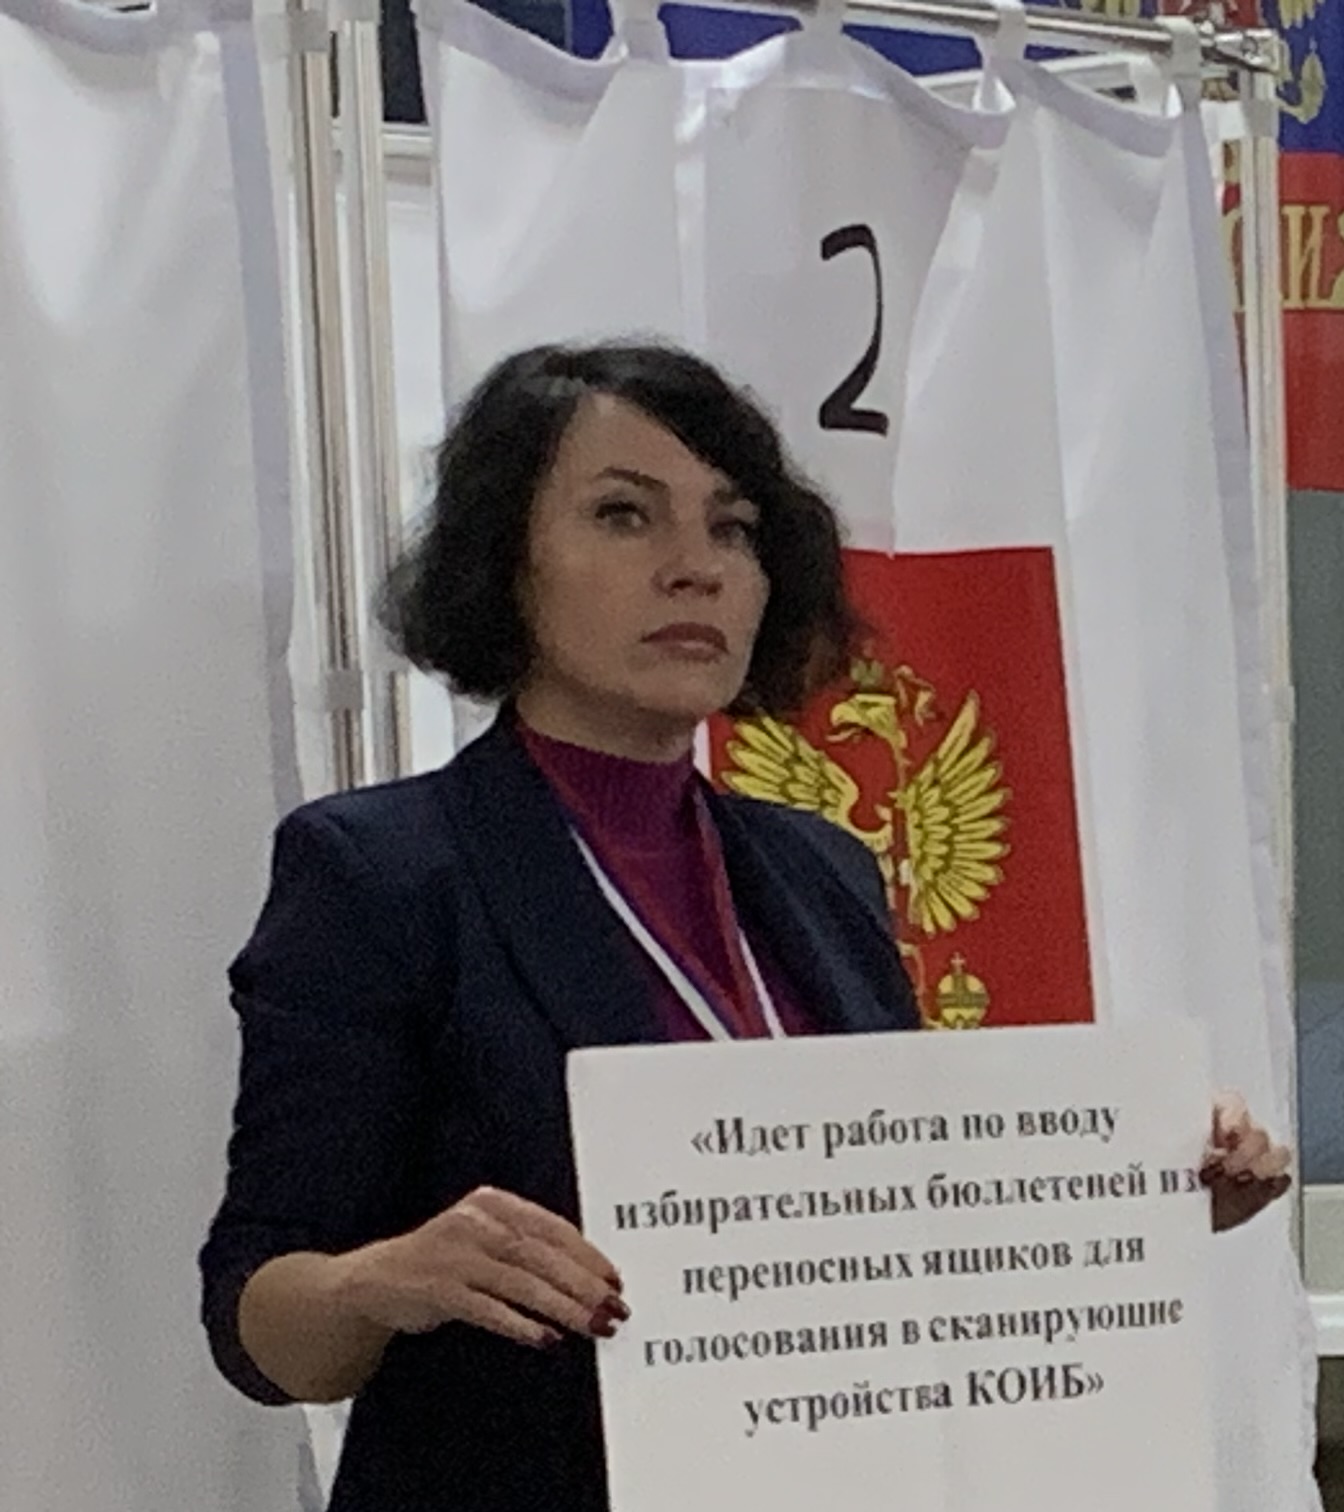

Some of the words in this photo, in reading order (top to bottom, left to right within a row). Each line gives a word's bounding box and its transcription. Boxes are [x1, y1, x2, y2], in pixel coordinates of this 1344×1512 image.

[819, 223, 889, 439] 2
[822, 1109, 949, 1159] работа
[962, 1114, 1005, 1140] по
[1017, 1107, 1118, 1144] вводу
[614, 1185, 917, 1234] избирательных
[927, 1162, 1147, 1209] бюллетеней
[1160, 1168, 1195, 1194] из
[683, 1253, 913, 1302] переносных
[922, 1242, 1073, 1276] ящиков
[1083, 1237, 1145, 1267] для
[644, 1321, 888, 1366] голосования
[902, 1320, 921, 1345] в
[744, 1380, 953, 1437] устройства
[966, 1363, 1104, 1406] КОИБ»
